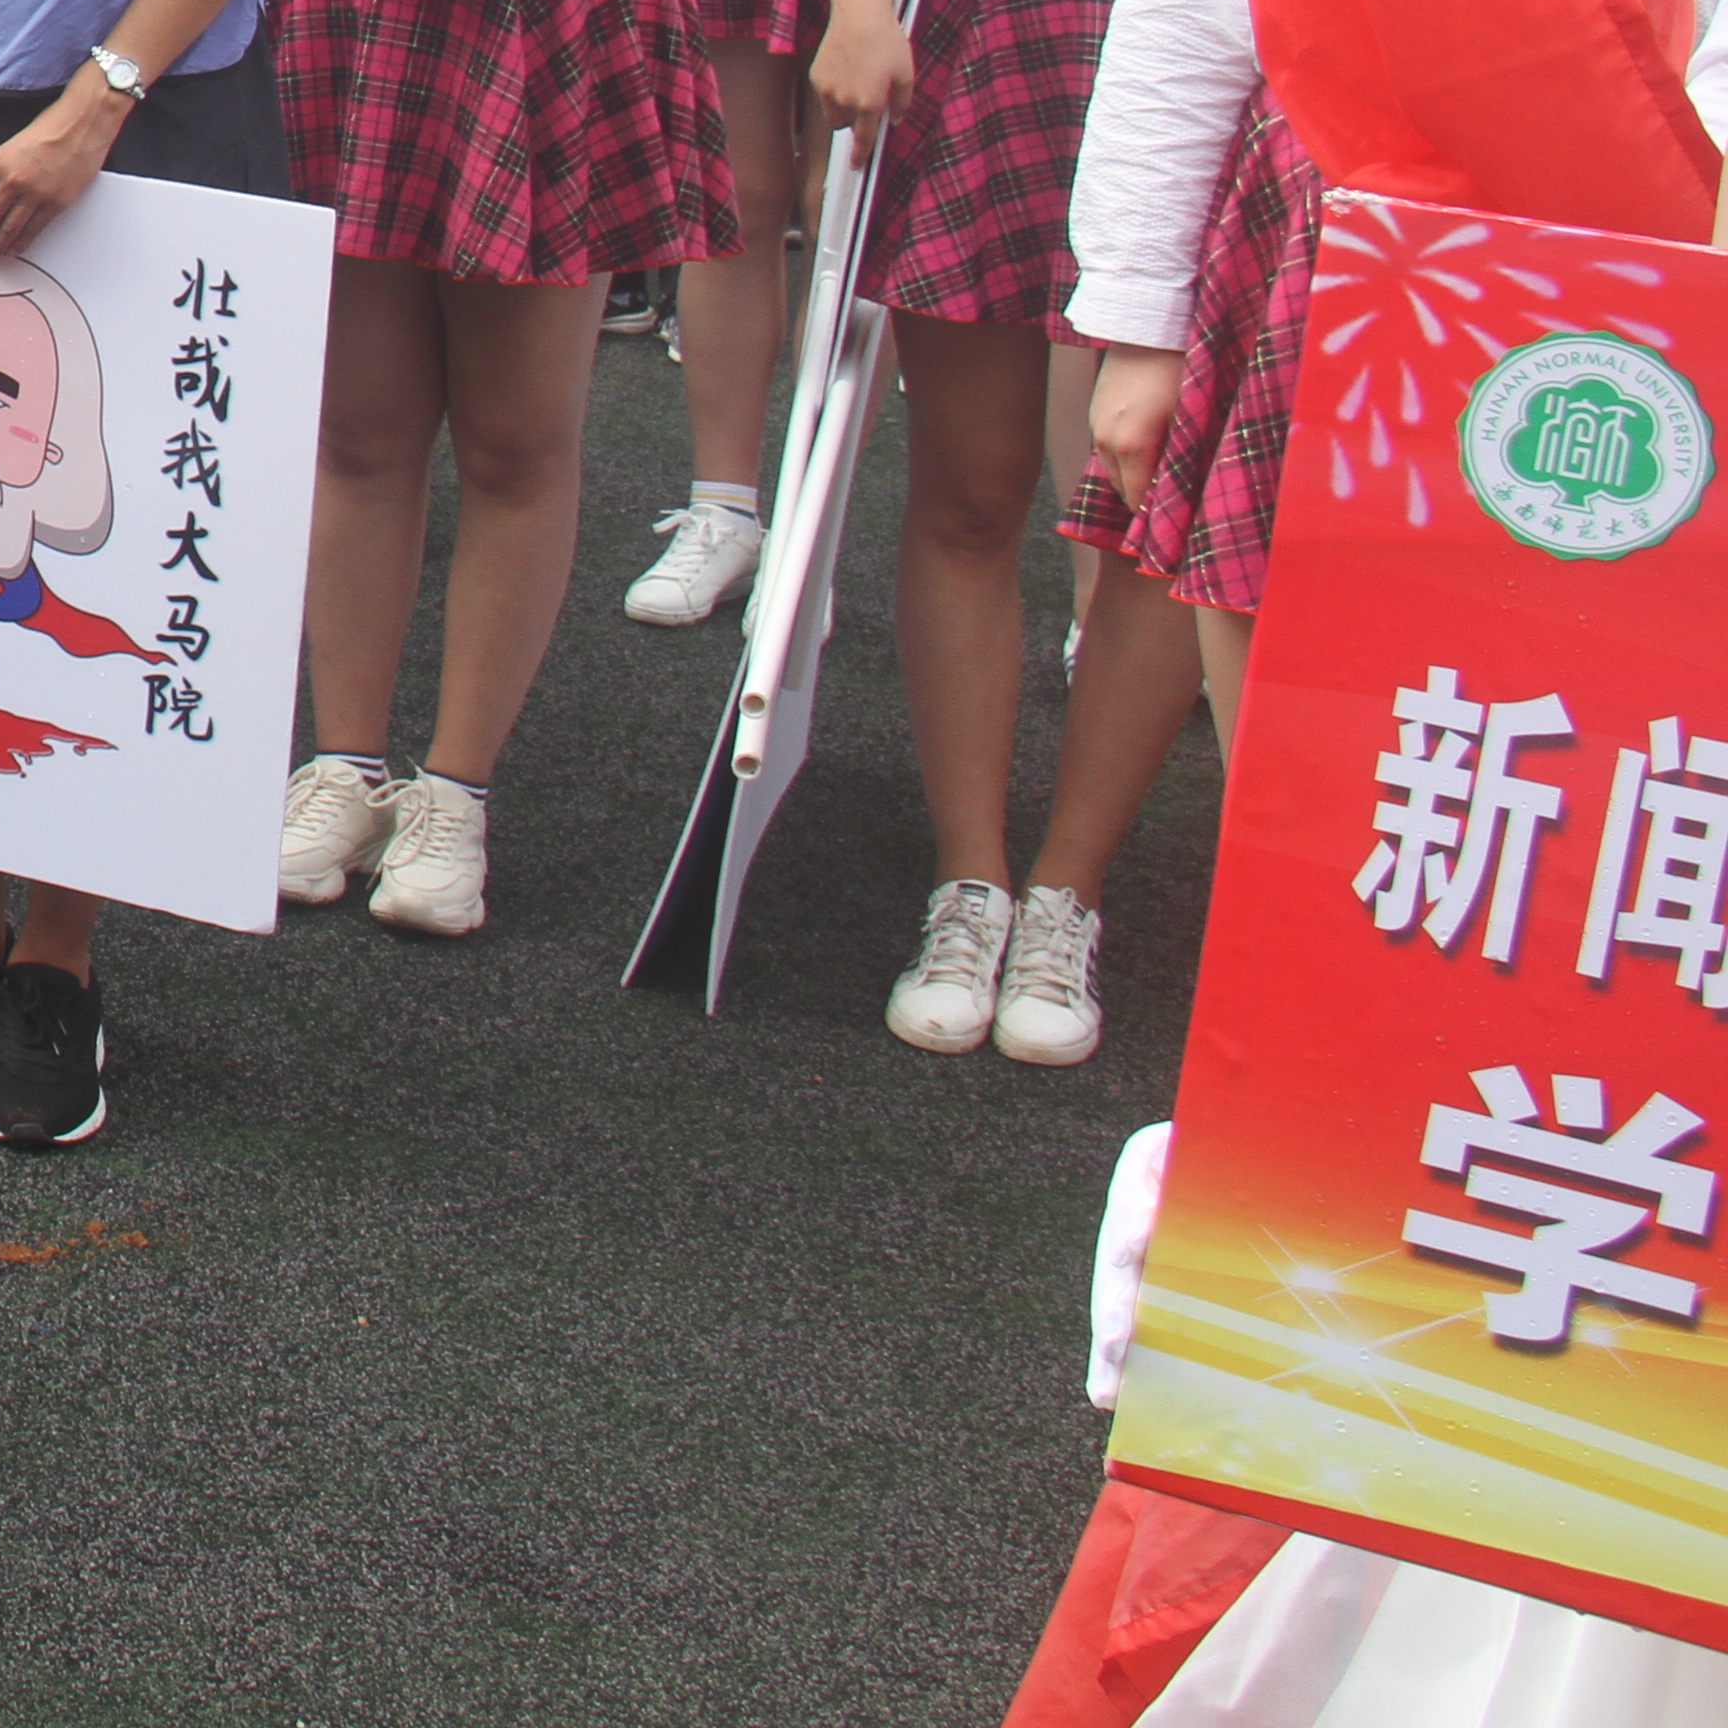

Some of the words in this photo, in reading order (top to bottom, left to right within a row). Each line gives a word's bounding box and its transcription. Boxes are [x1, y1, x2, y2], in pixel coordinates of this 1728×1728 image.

[143, 258, 240, 742] 壮哉我大马院
[1480, 368, 1530, 443] HAINAN
[1532, 350, 1630, 375] NORMAL
[1633, 368, 1693, 479] UNIVERSITY
[1401, 1064, 1717, 1343] 学
